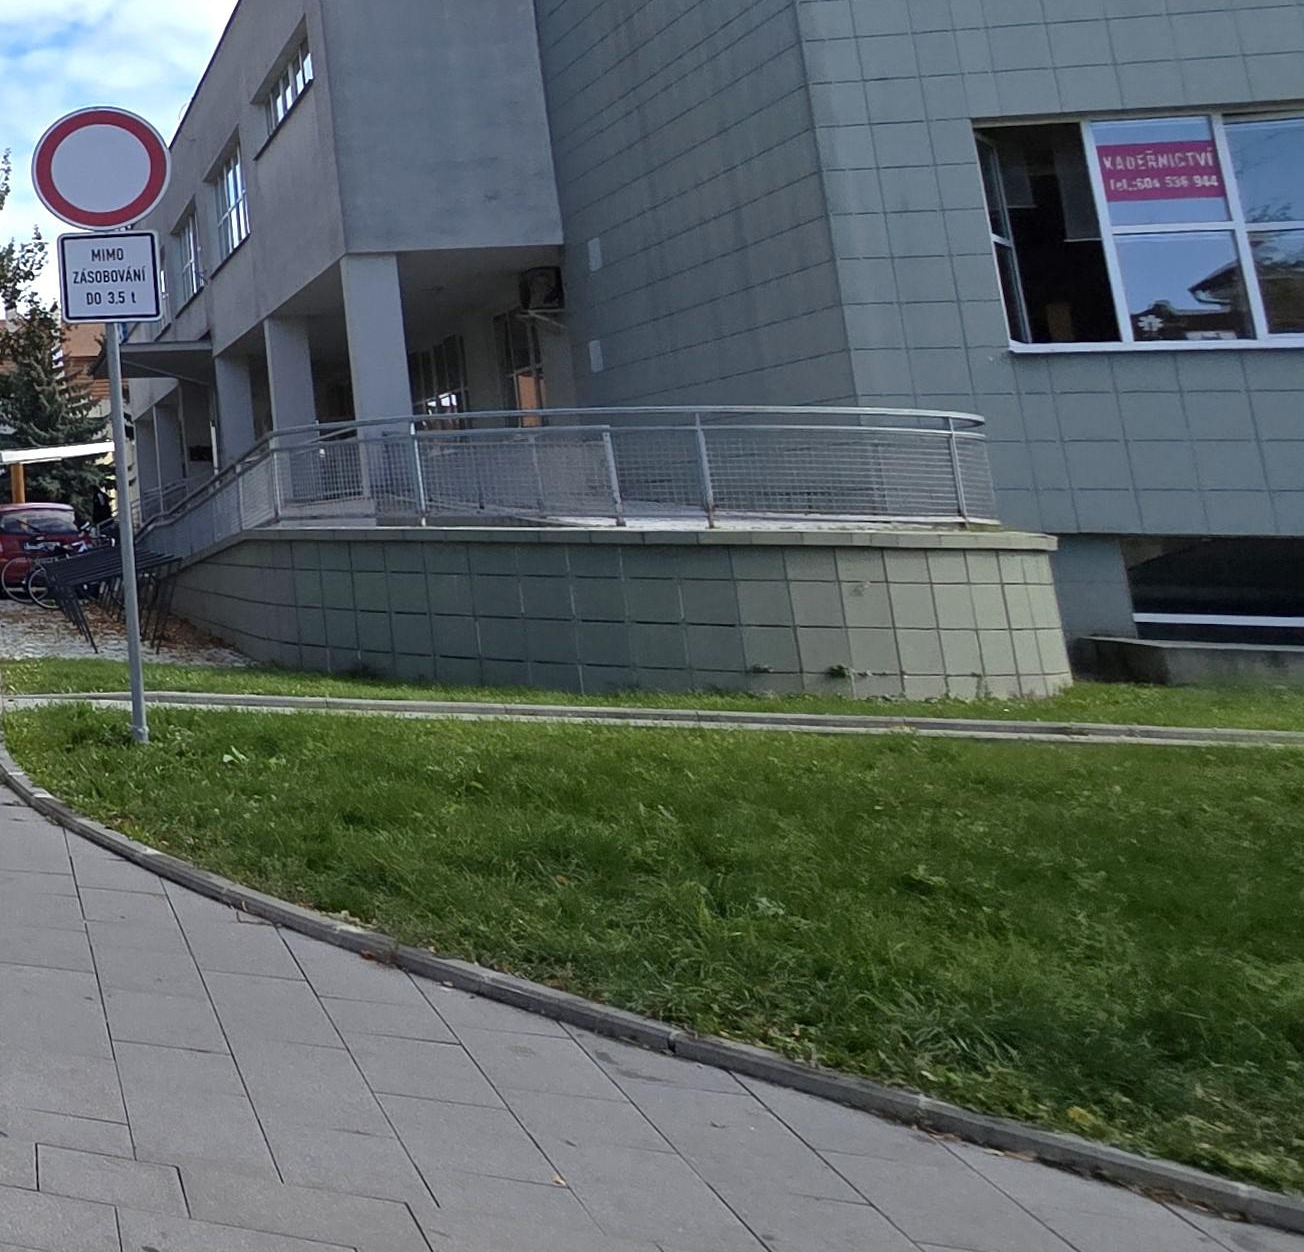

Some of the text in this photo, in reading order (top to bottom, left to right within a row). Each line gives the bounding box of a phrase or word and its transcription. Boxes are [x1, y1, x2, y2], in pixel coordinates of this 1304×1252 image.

[91, 248, 124, 261] MIMO
[73, 266, 146, 284] ZÁSOBOVÁNÍ
[86, 292, 102, 305] DO
